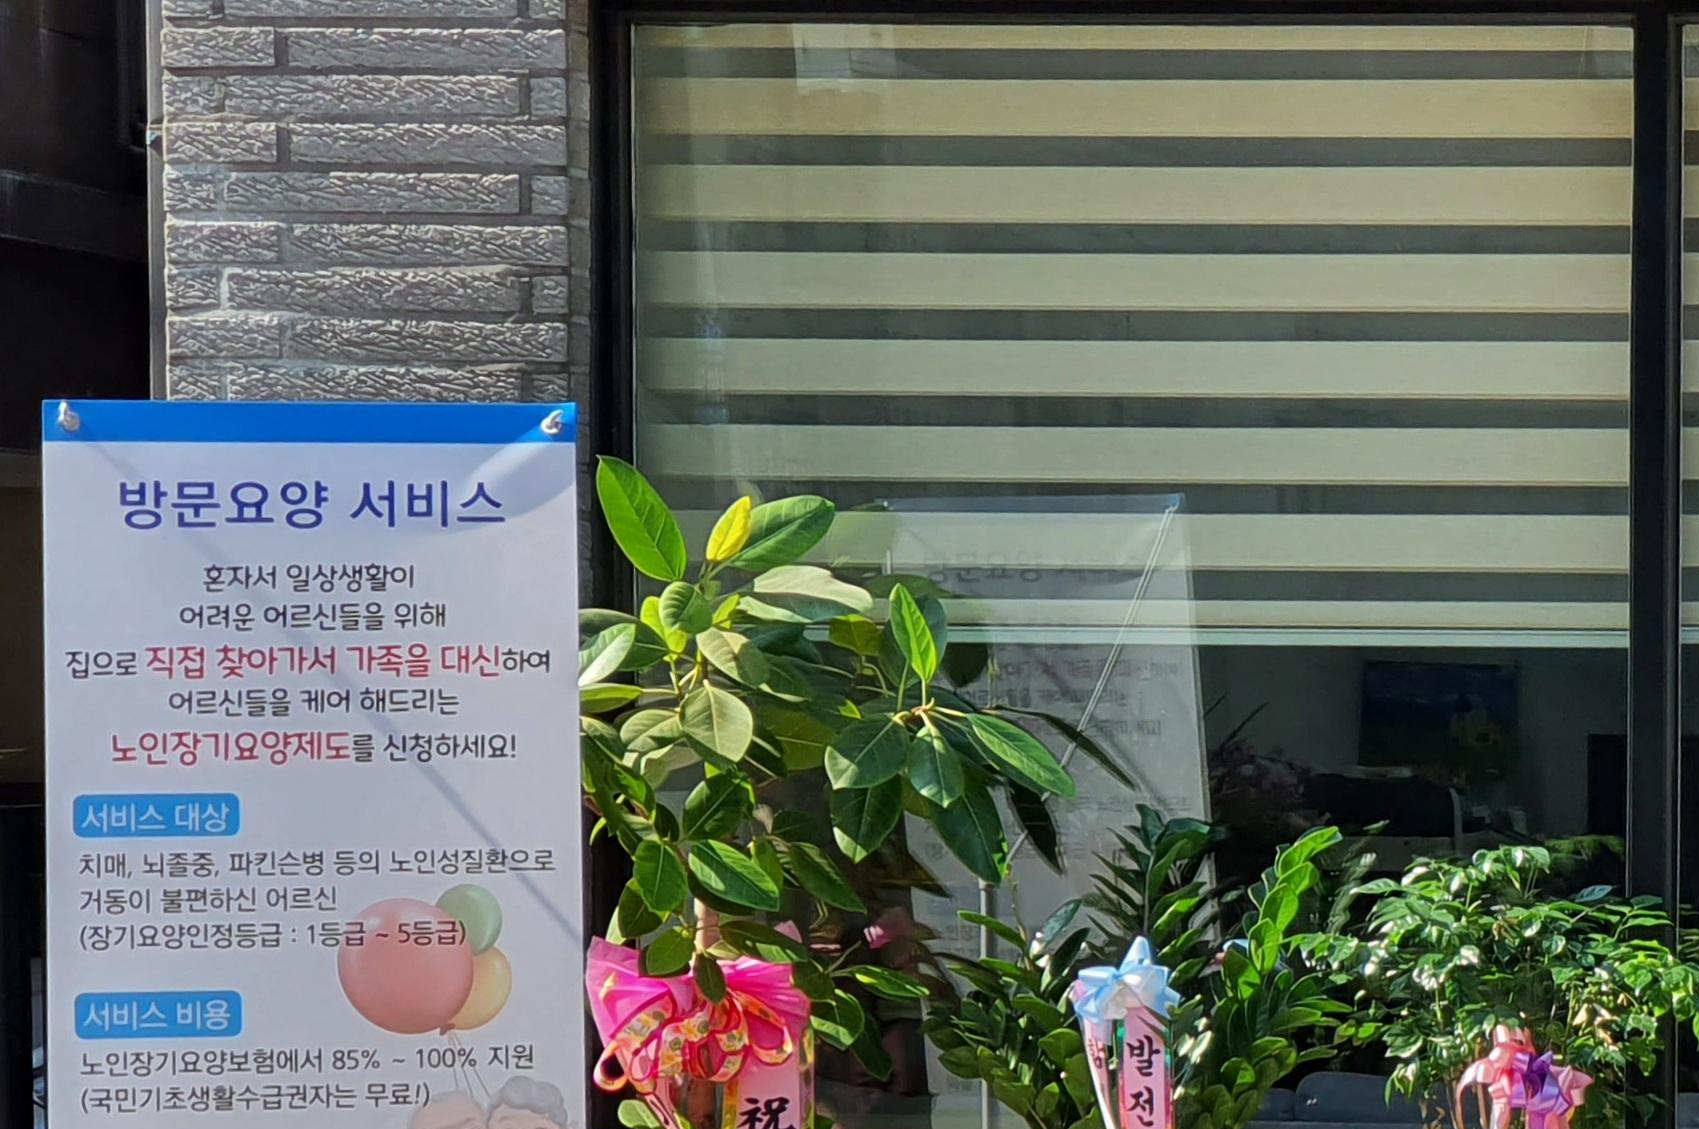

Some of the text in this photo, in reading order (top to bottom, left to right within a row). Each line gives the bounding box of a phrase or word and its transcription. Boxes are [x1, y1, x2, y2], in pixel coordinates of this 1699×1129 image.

[119, 480, 506, 530] 방문요양 서비스
[203, 563, 414, 593] 혼자서 일상생활이
[179, 601, 446, 632] 어려운 어르신들을 위해
[65, 643, 551, 680] 집으로 직접 찾아가서 가족을 대신하여
[168, 686, 460, 718] 어르신들을 케어 해드리는
[112, 730, 516, 766] 노인장기요양제도를 신청하세요!
[81, 802, 230, 833] 서비스 대상
[79, 848, 556, 879] 치매, 뇌졸중, 파킨슨병 등의 노인성질환으로
[79, 886, 337, 915] 거동이 불편하신 어르신
[79, 919, 466, 951] (장기요양인정등급 1등급 5등급)
[82, 999, 231, 1032] 서비스 비용
[80, 1044, 534, 1077] 노인장기요양보험에서 85% 100% 지원
[81, 1082, 430, 1114] (국민기초생활수급권자는 무료!)
